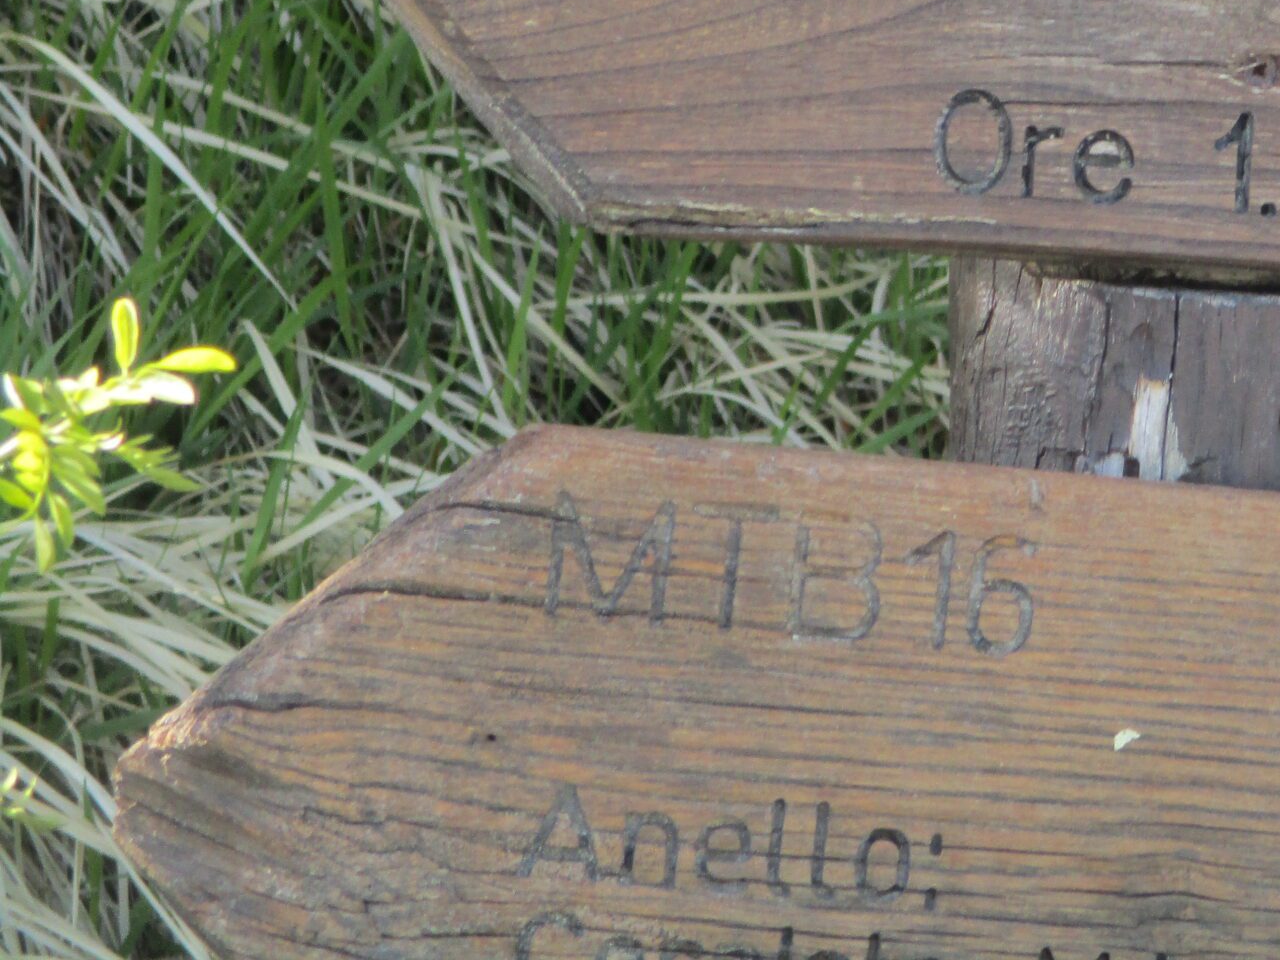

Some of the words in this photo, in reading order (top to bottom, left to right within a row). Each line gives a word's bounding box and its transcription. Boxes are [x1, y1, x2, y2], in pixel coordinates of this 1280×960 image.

[935, 88, 1135, 205] Ore
[544, 489, 882, 640] MTB
[905, 530, 1035, 657] 16
